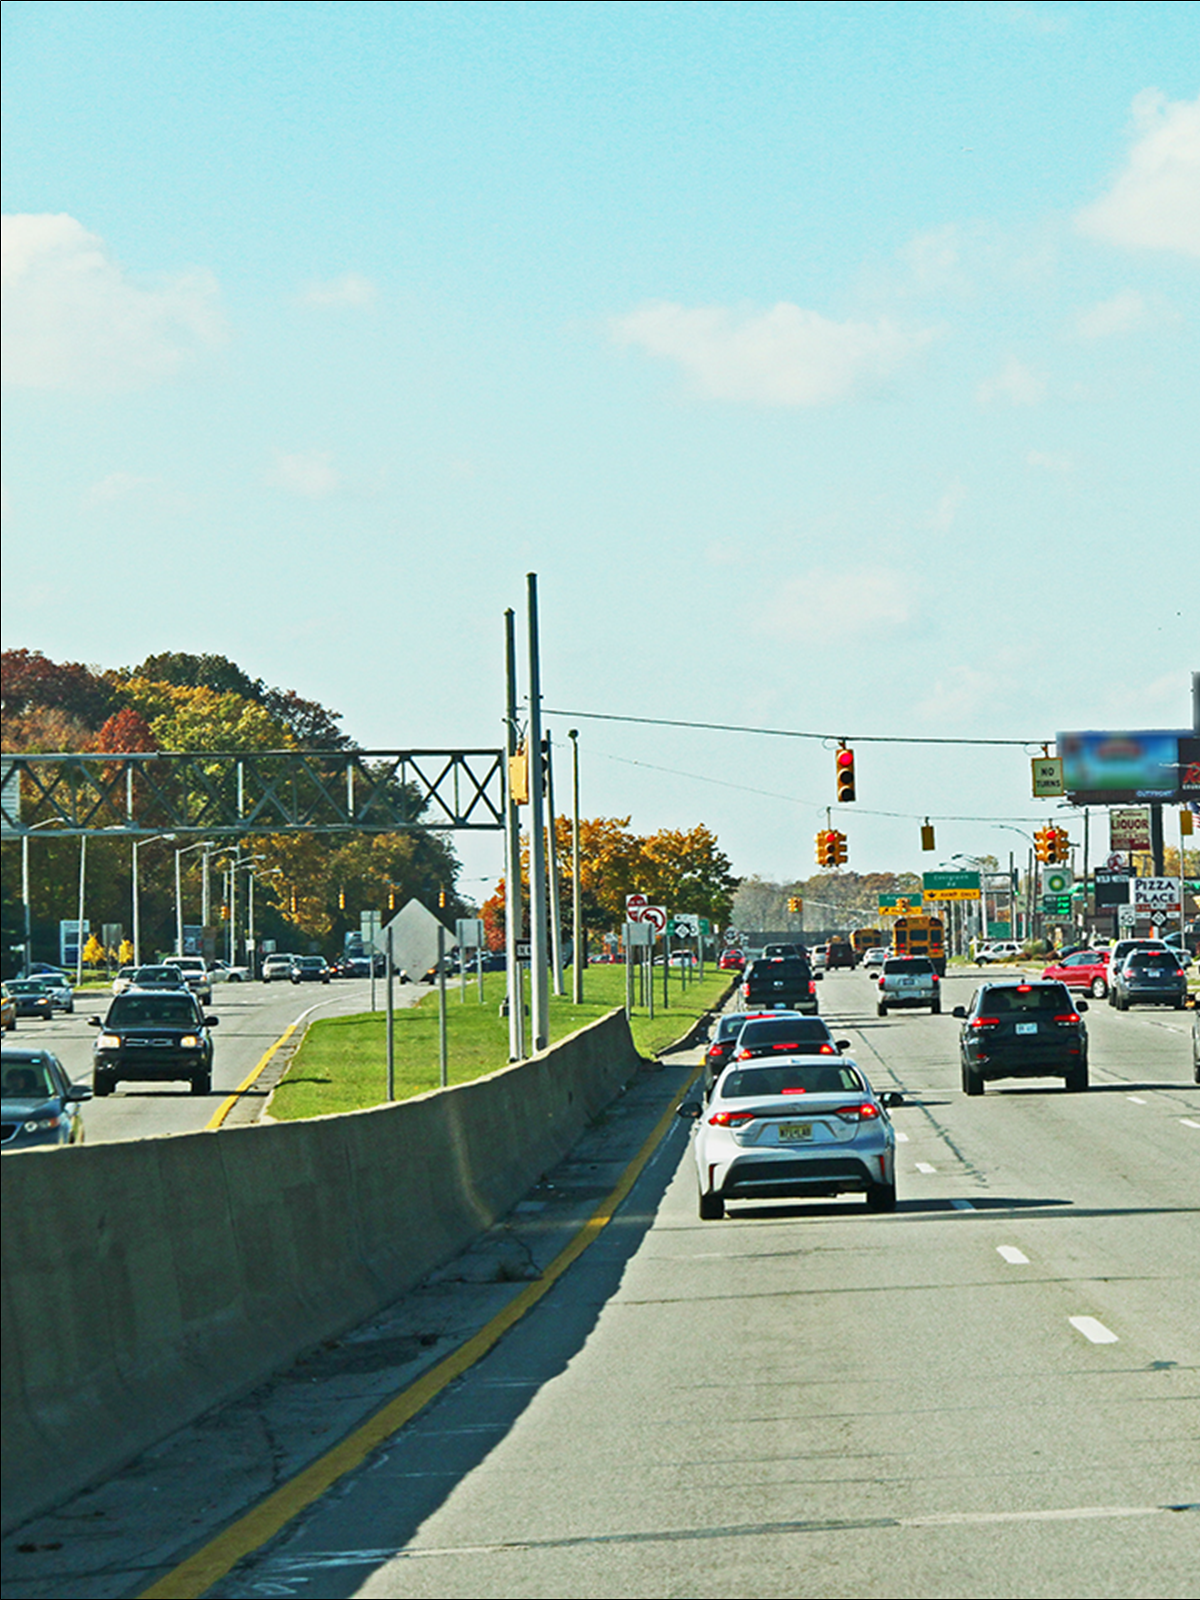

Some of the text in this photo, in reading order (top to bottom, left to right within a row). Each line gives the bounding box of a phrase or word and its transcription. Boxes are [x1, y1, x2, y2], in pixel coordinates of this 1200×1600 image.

[1041, 767, 1055, 776] NO
[1036, 780, 1061, 788] TURNS
[1110, 819, 1149, 830] LIQUOR
[1135, 878, 1175, 890] PIZZA
[1135, 892, 1176, 903] PLACE
